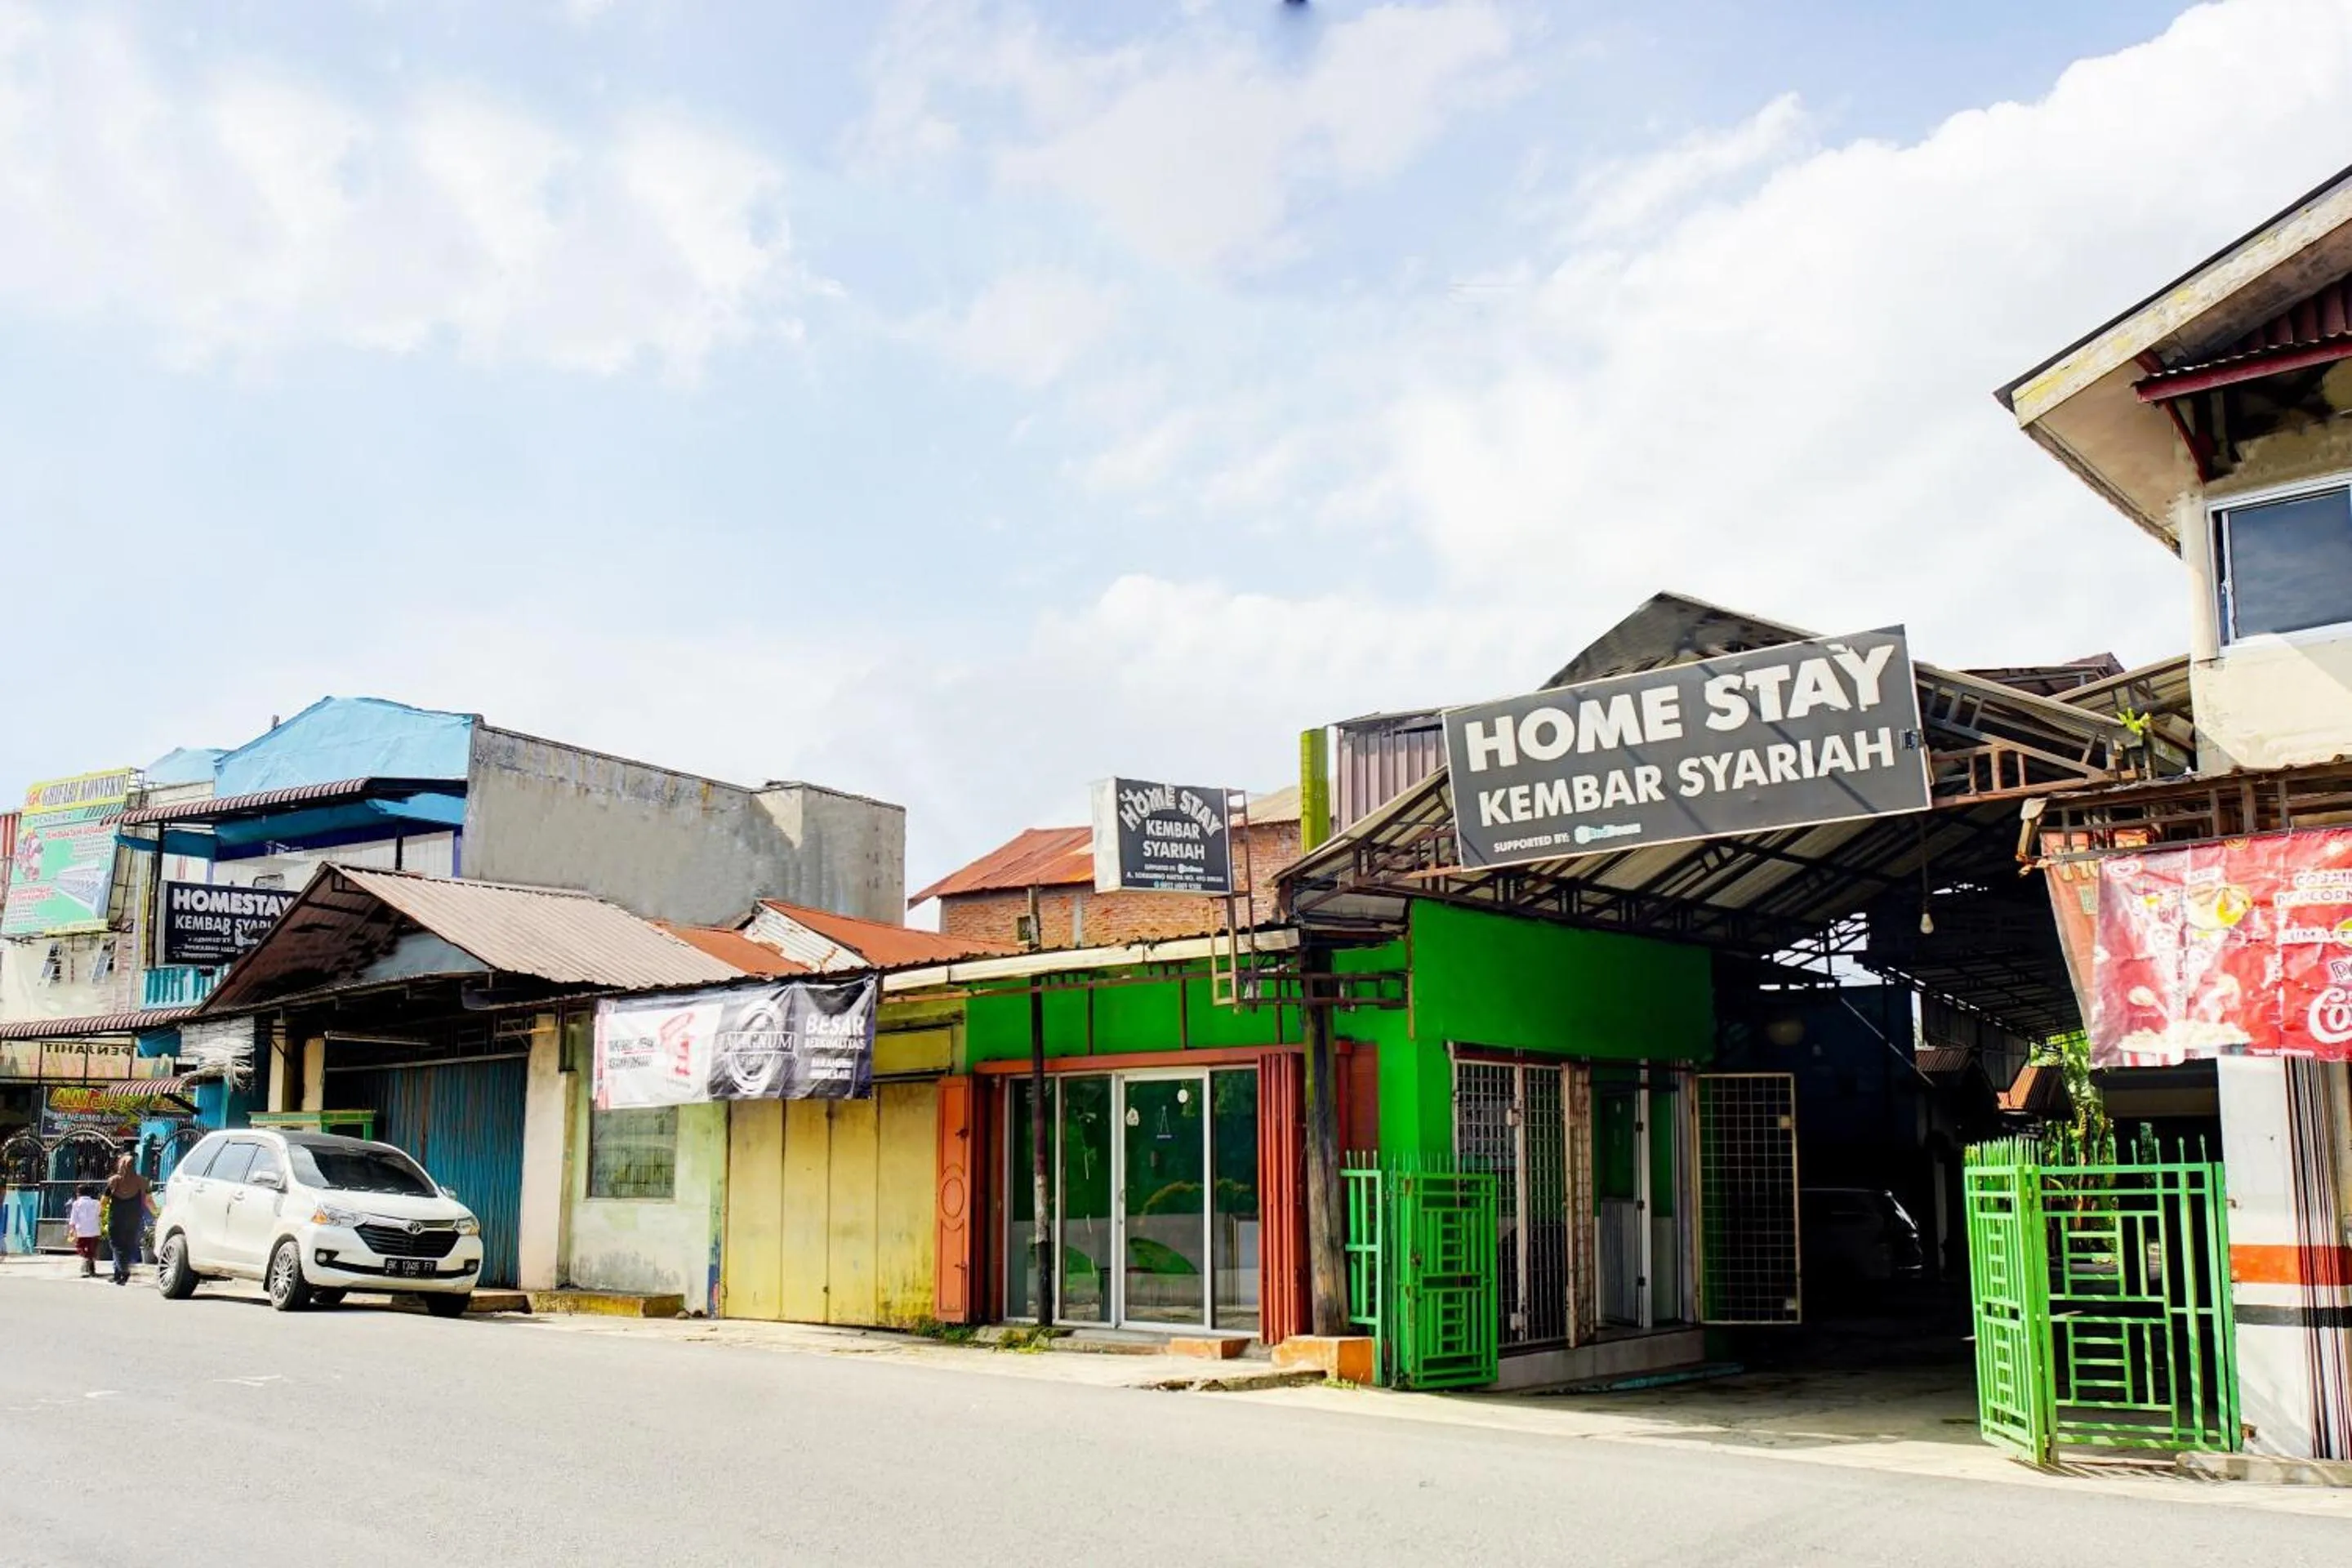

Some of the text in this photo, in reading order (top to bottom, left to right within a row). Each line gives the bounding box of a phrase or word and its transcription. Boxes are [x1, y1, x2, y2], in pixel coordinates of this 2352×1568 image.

[1465, 643, 1895, 772] HOME STAY
[1478, 728, 1895, 827] KEMBAR SYARIAH
[1119, 784, 1223, 837] HOME STAY
[1146, 819, 1200, 840] KEMBAR
[1143, 840, 1205, 860] SYARIAH
[1494, 835, 1552, 853] SUPPORTED
[173, 889, 294, 916] HOMESTAY
[175, 914, 231, 934] KEMBAR
[806, 1013, 866, 1036] BESAR
